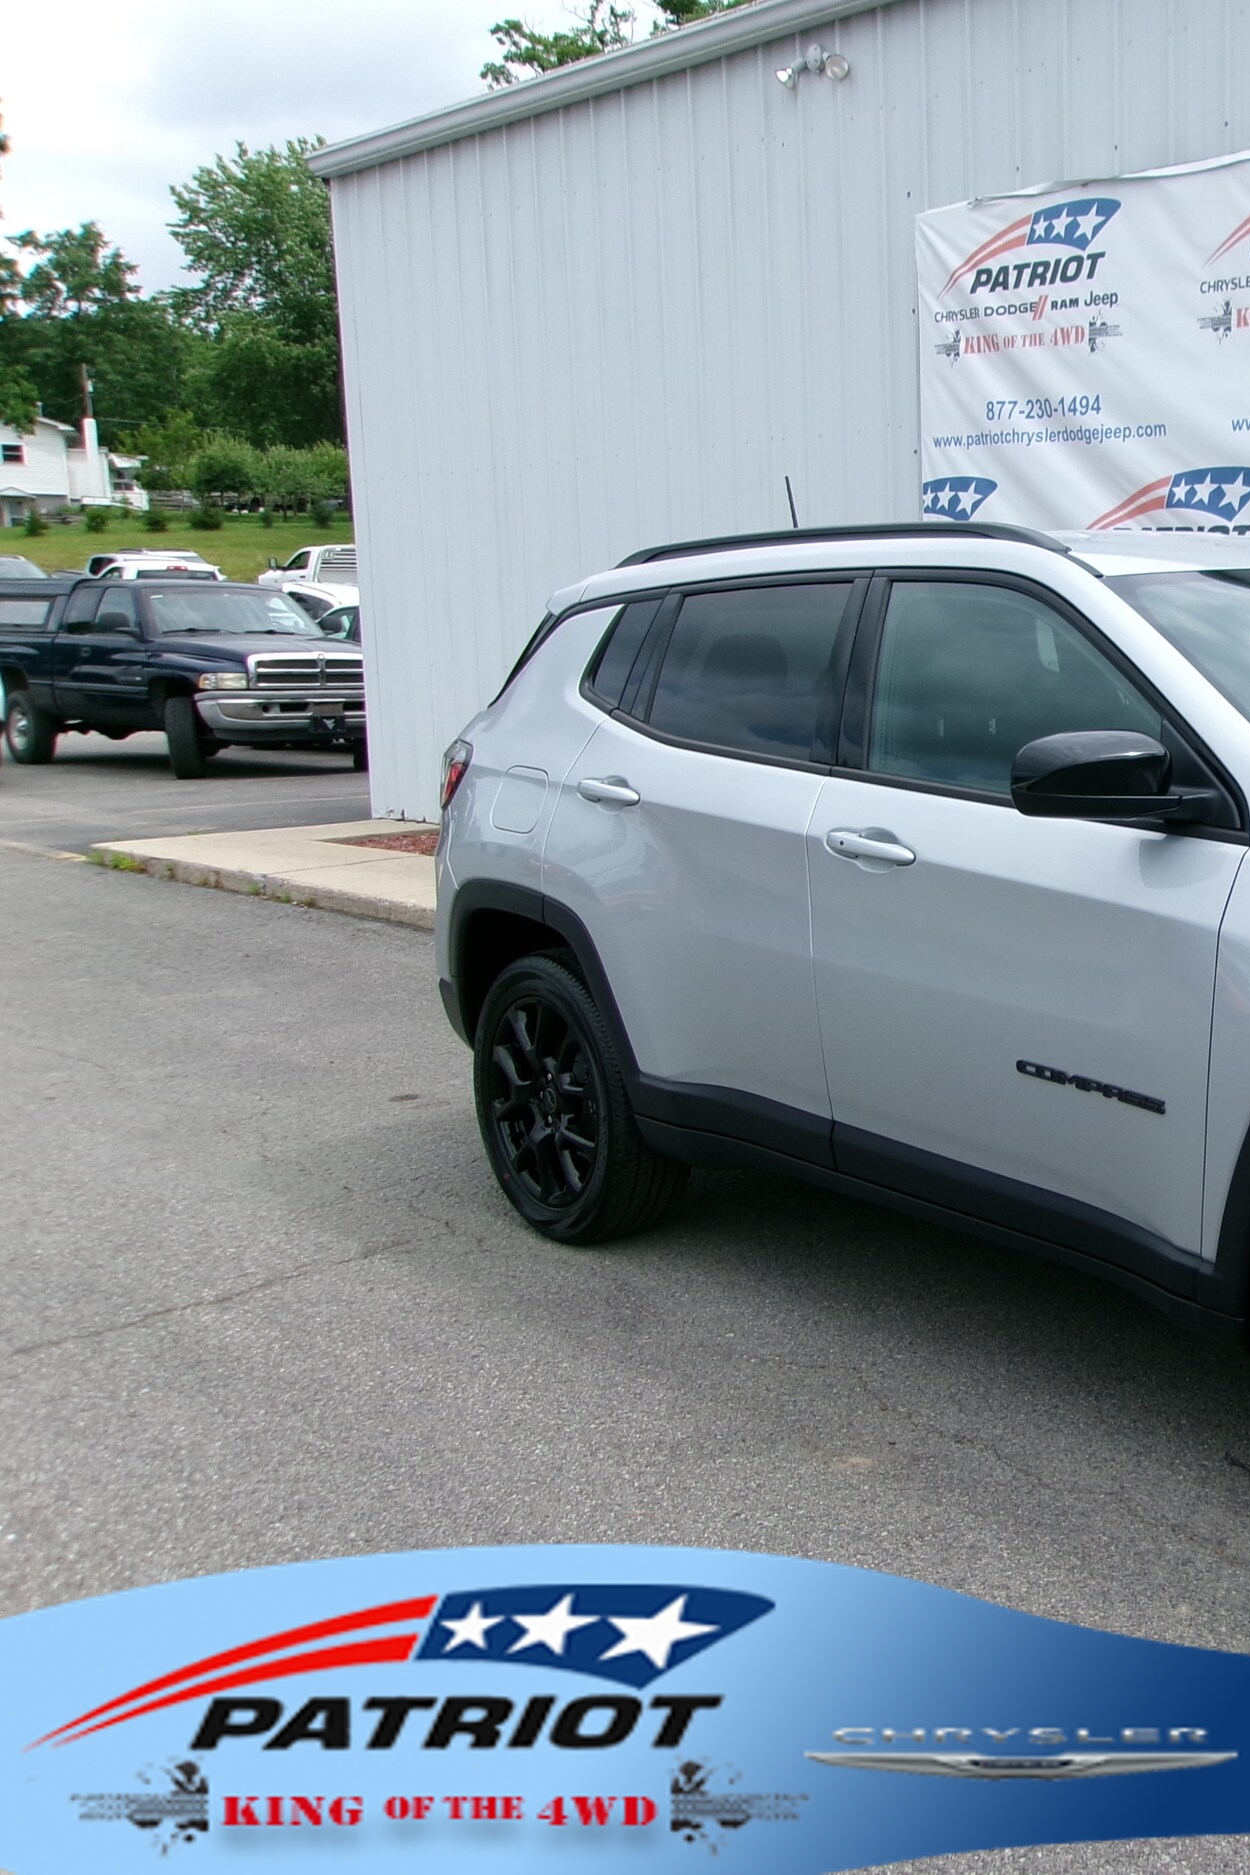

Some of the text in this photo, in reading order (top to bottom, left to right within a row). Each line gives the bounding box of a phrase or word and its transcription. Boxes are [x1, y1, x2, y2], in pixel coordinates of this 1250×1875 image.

[969, 251, 1106, 295] PATRIOT
[934, 308, 980, 324] CHRYSLER
[1050, 297, 1080, 312] RAM
[1083, 290, 1118, 308] Jeep
[963, 325, 1086, 355] KING OF THE 4WD
[985, 394, 1102, 421] 877-230-1494
[933, 422, 1167, 449] www.patriotchryslerdodgejeep.com
[1016, 1059, 1166, 1115] COMPASS
